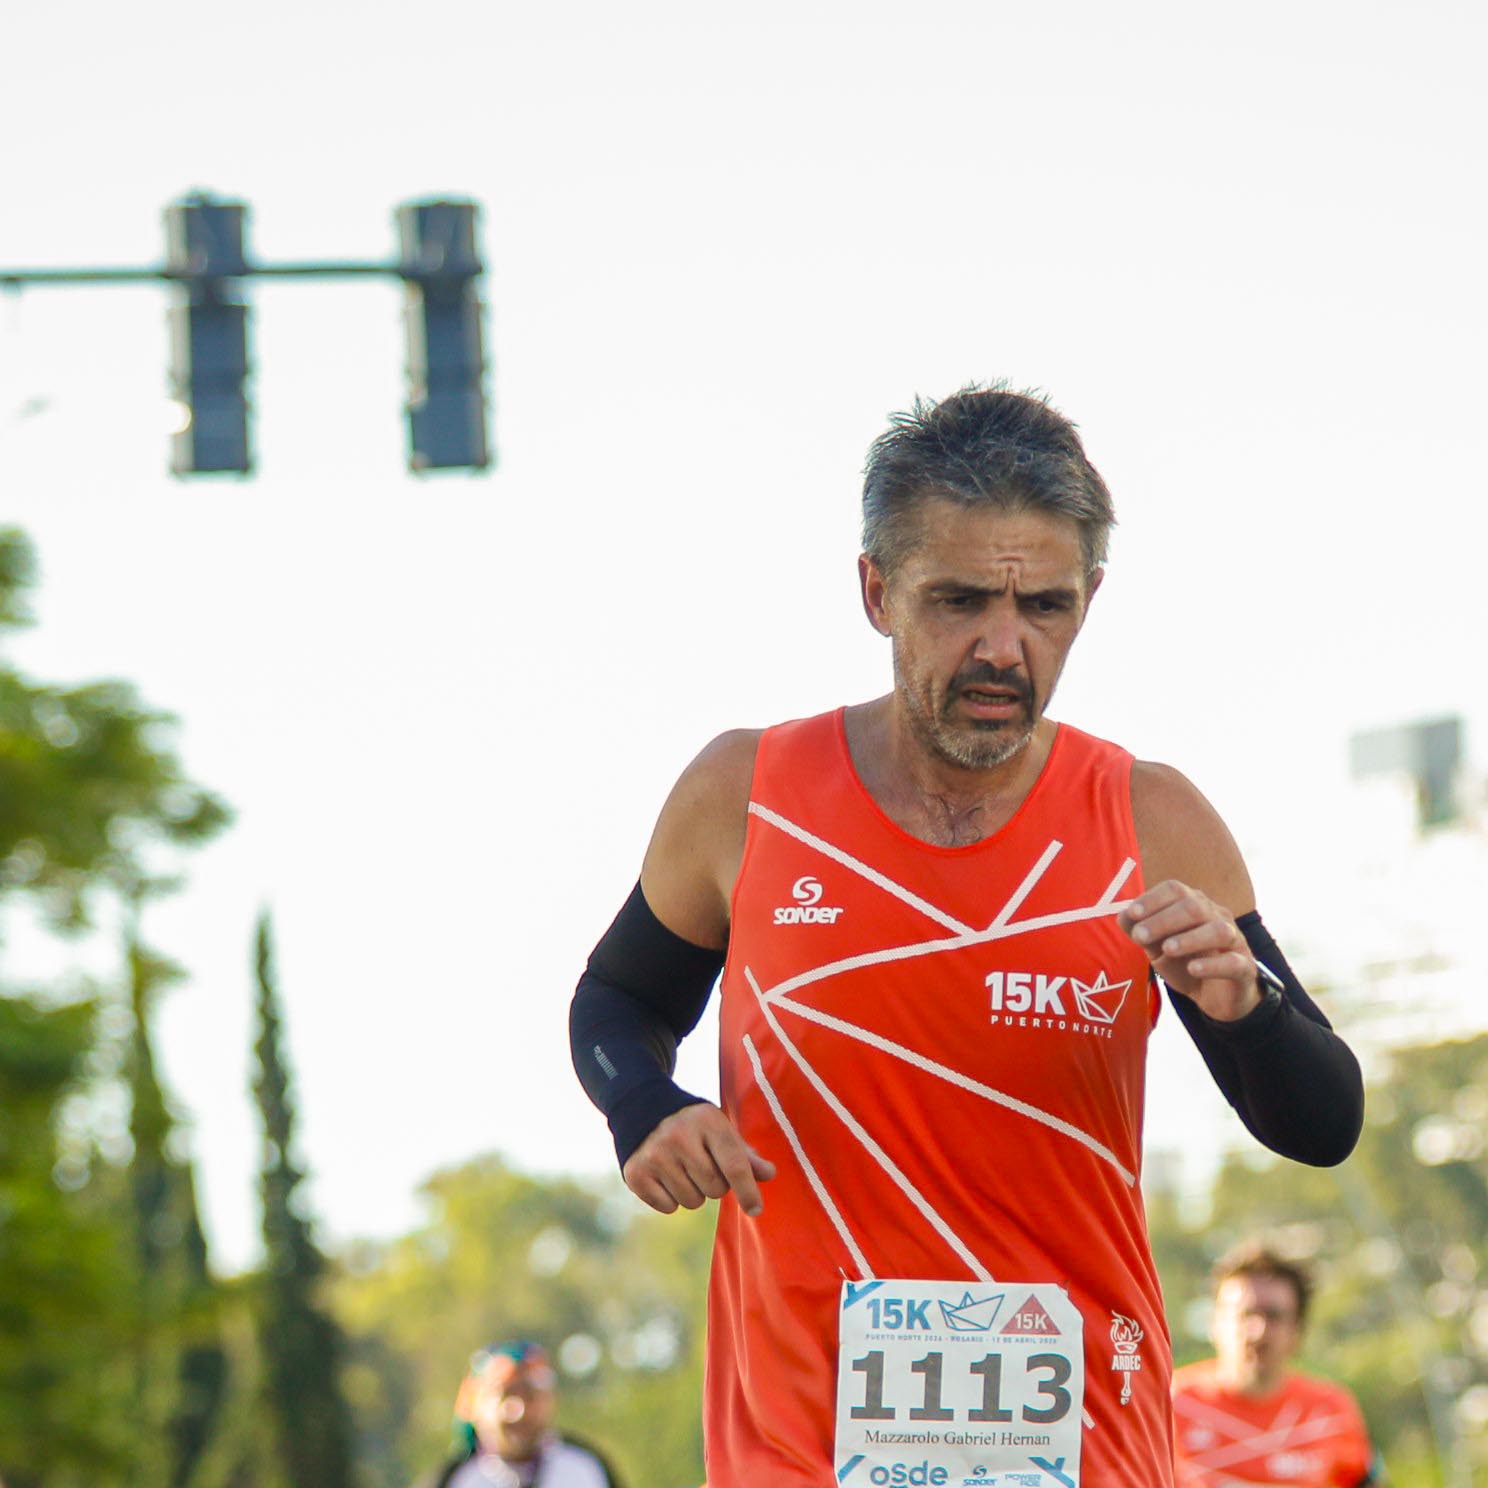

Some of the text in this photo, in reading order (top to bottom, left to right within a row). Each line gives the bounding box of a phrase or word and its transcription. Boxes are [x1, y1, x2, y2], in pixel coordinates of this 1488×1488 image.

[985, 971, 1068, 1016] 15K
[991, 1015, 1113, 1039] PUERTO NORTE
[866, 1298, 933, 1331] 15K
[1014, 1313, 1048, 1330] 15K
[1112, 1354, 1141, 1371] ARDEC
[850, 1351, 1072, 1424] 1113
[865, 1429, 1051, 1446] Mazzarolo Gabriel Hernan
[870, 1460, 949, 1487] osde
